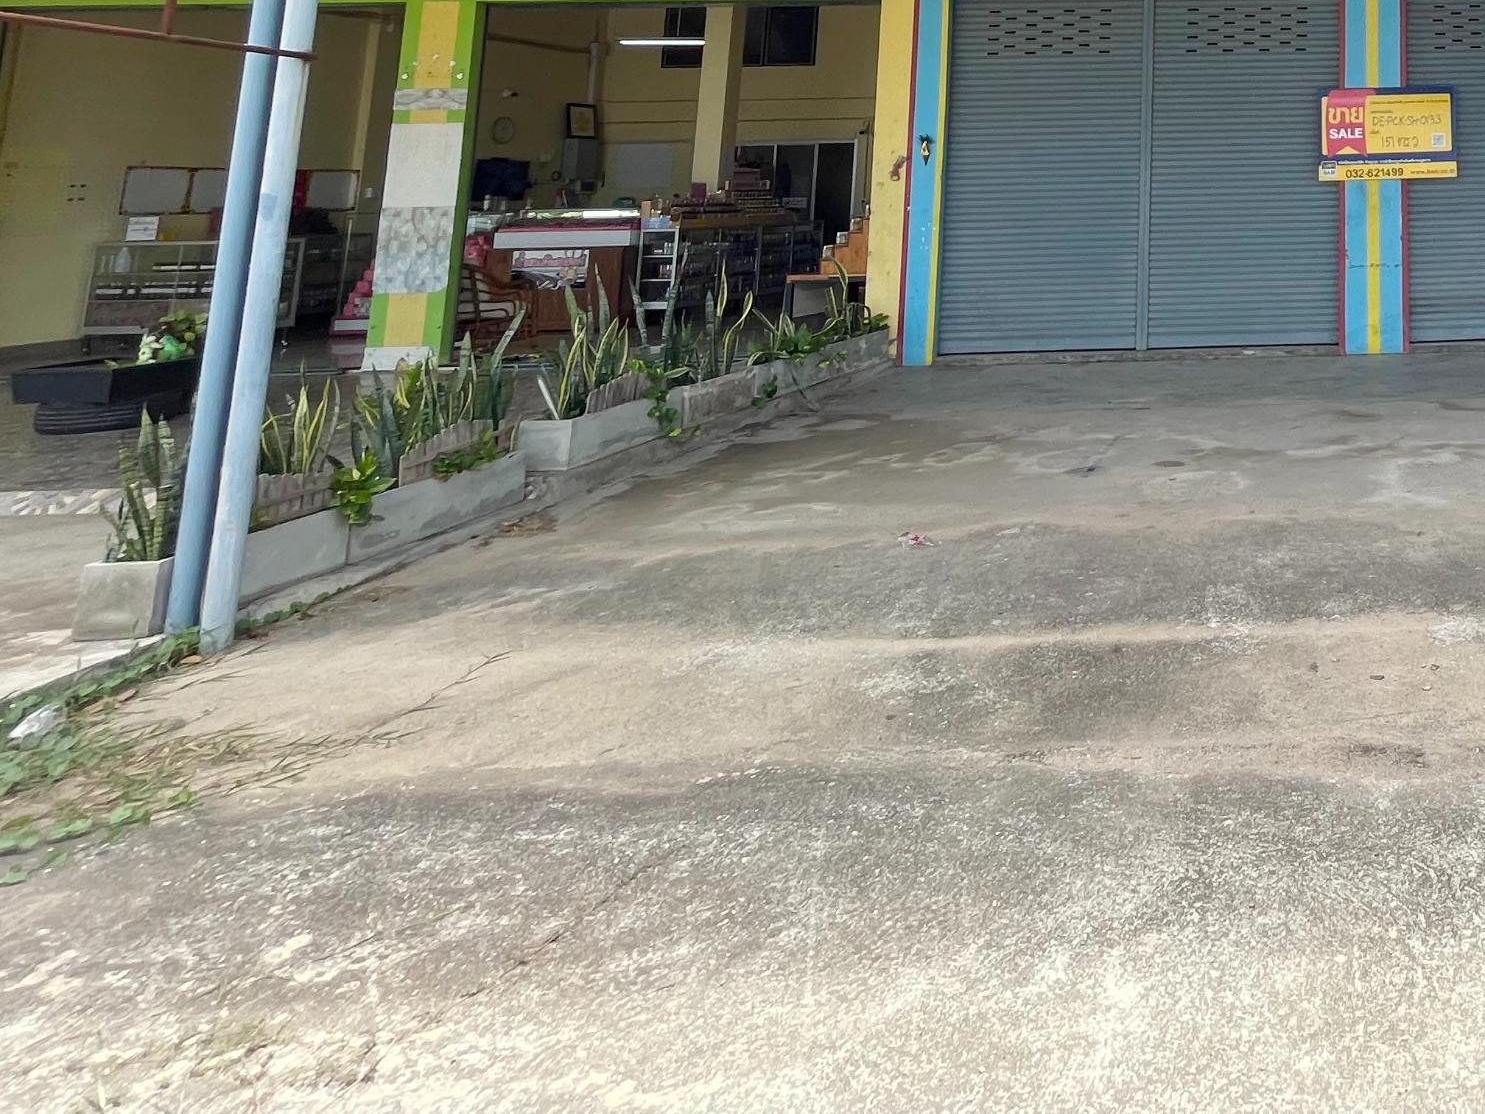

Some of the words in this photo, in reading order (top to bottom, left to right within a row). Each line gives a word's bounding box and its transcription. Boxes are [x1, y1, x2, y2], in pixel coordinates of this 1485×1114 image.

[1328, 106, 1363, 124] ขาย
[1329, 128, 1363, 139] SALE
[1345, 167, 1405, 179] 032-621499
